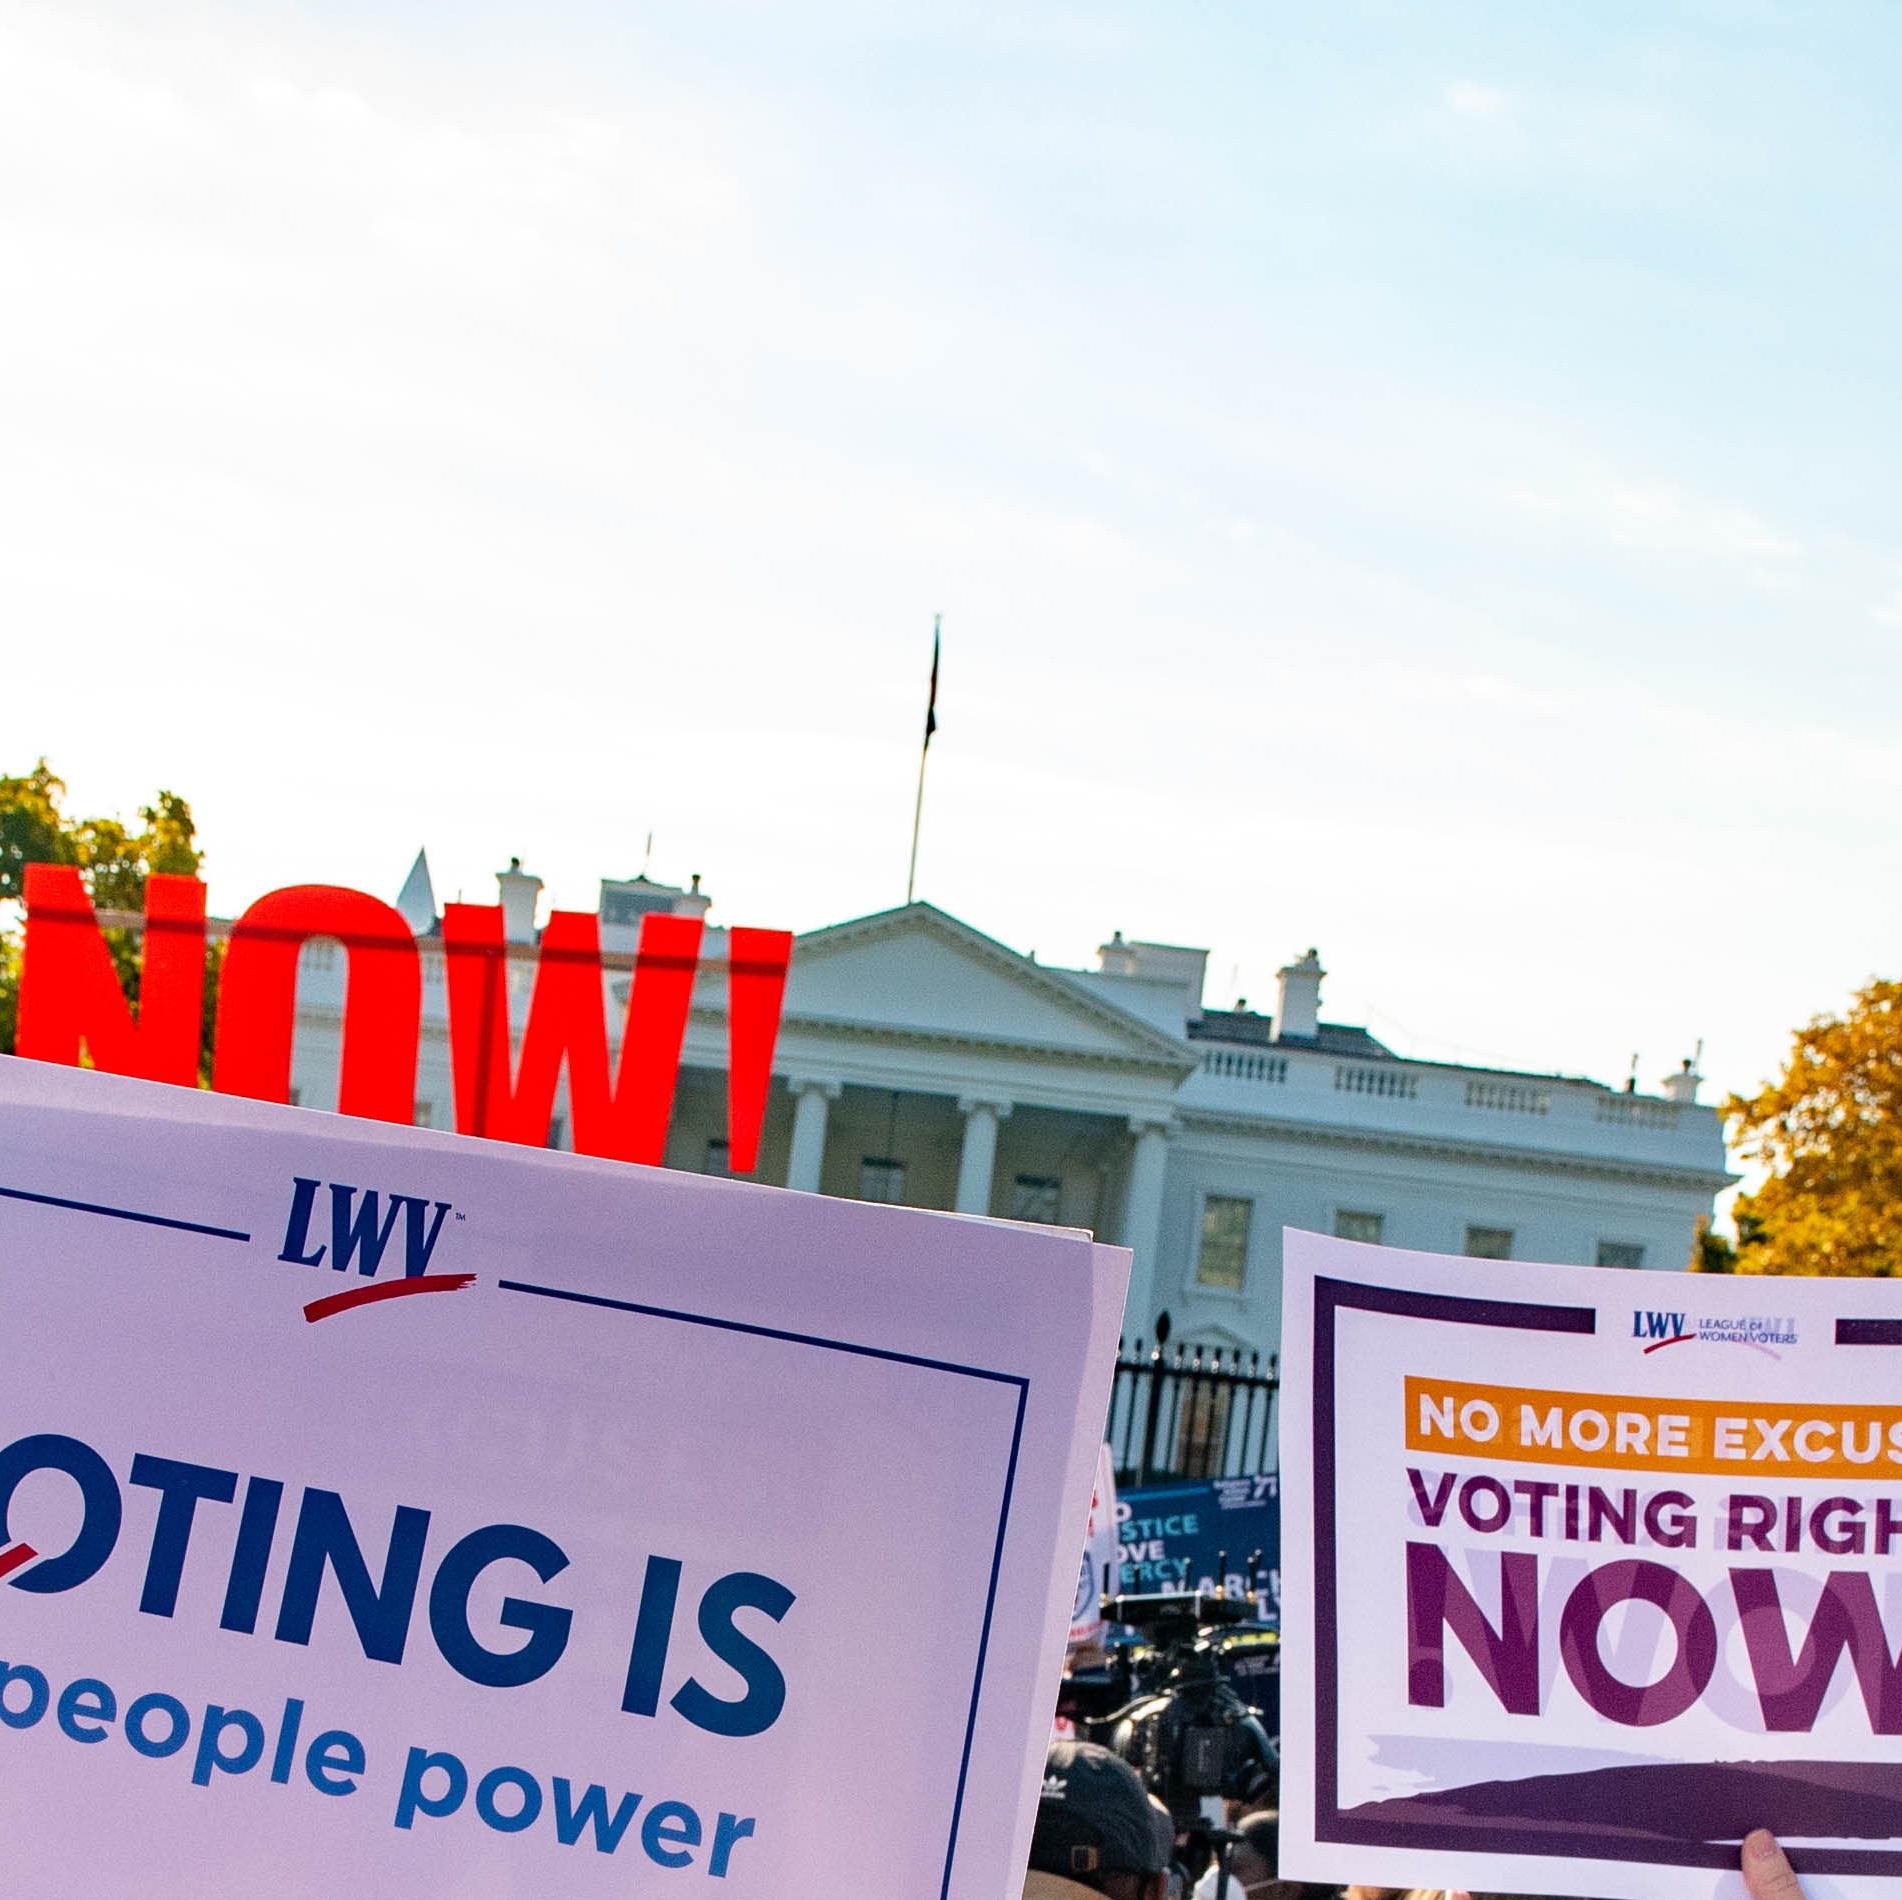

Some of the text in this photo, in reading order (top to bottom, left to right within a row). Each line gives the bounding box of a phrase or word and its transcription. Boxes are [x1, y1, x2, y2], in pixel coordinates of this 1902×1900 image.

[15, 863, 794, 1173] NOW!
[277, 1176, 452, 1279] LWV
[1633, 1311, 1686, 1338] LWV
[1699, 1318, 1746, 1330] LEAGUE
[1699, 1331, 1798, 1344] WOMEN VOTERS
[1419, 1393, 1500, 1443] NO
[1520, 1405, 1691, 1458] MORE
[1117, 1514, 1198, 1542] STICE
[1406, 1467, 1697, 1549] VOTING
[1119, 1558, 1188, 1583] ERCY
[621, 1554, 797, 1738] IS
[394, 1746, 757, 1879] power
